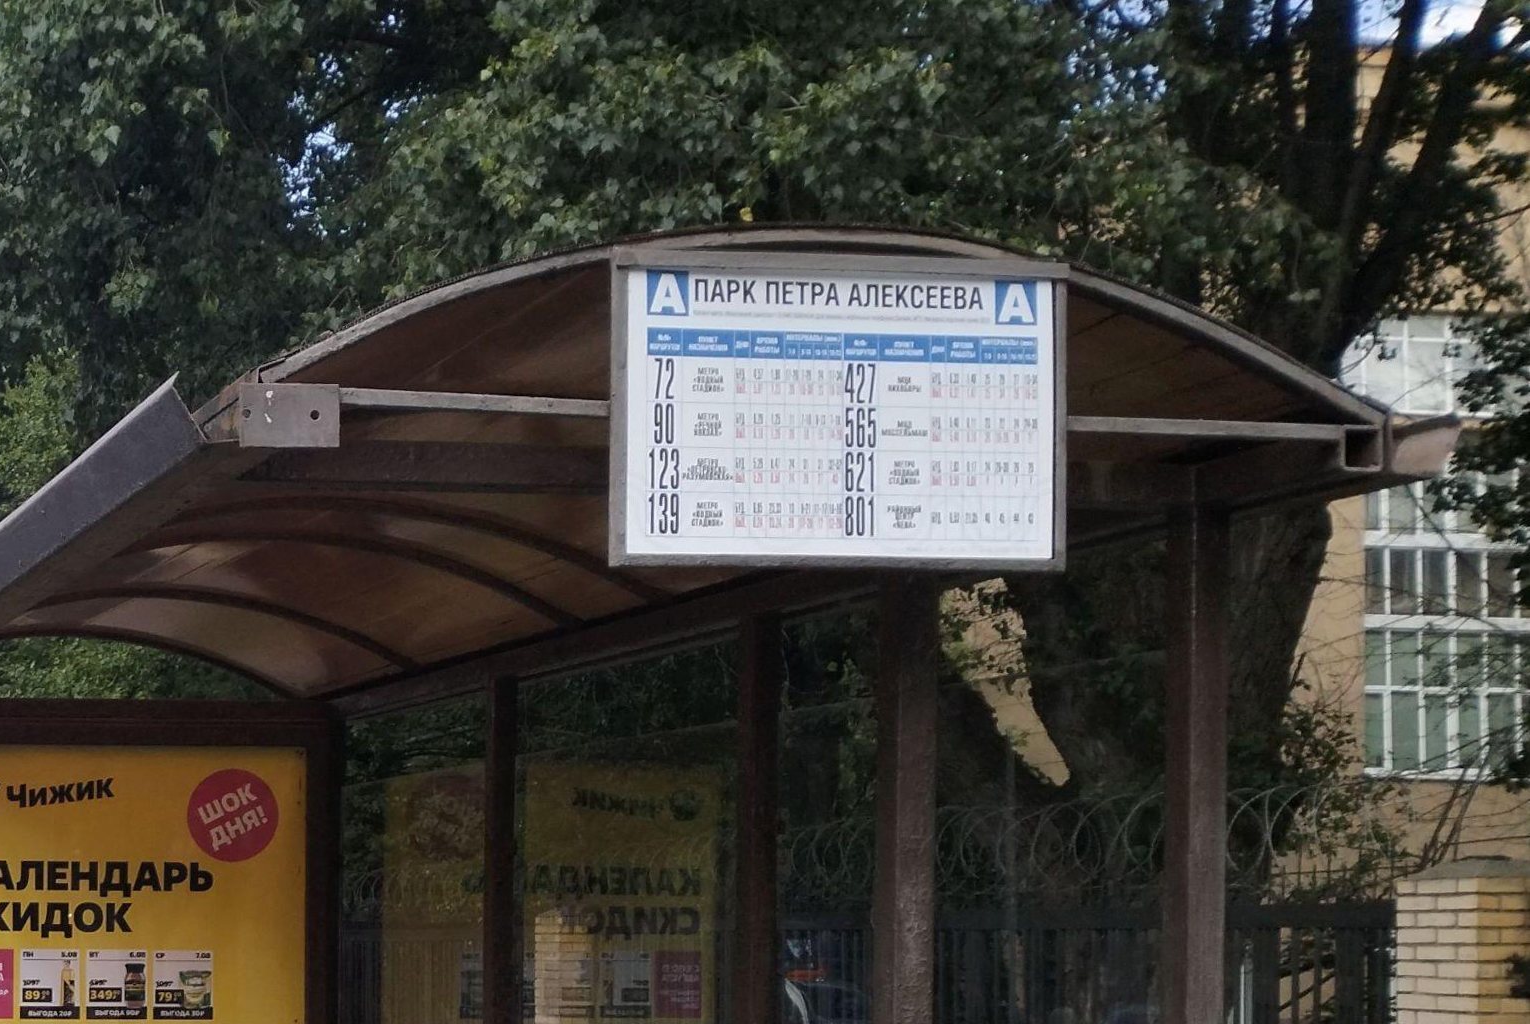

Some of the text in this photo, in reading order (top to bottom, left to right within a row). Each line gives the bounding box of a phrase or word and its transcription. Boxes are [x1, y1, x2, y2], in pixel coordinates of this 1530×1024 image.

[694, 278, 756, 304] ПАРК
[766, 280, 840, 307] ПЕТРА
[848, 283, 983, 310] АЛЕКСЕЕВА
[654, 358, 675, 399] 72
[697, 367, 719, 376] МЕТРО
[844, 362, 876, 403] 427
[653, 403, 674, 444] 90
[697, 412, 718, 420] МЕТРО
[845, 408, 877, 449] 565
[649, 448, 680, 489] 123
[845, 451, 874, 492] 621
[649, 493, 680, 534] 139
[697, 502, 718, 510] МЕТРО
[845, 496, 874, 536] 801
[6, 777, 115, 809] Чижик
[197, 783, 258, 825] ШОК
[209, 806, 269, 852] ДНЯ!
[24, 989, 40, 1000] 89
[158, 991, 172, 1001] 79
